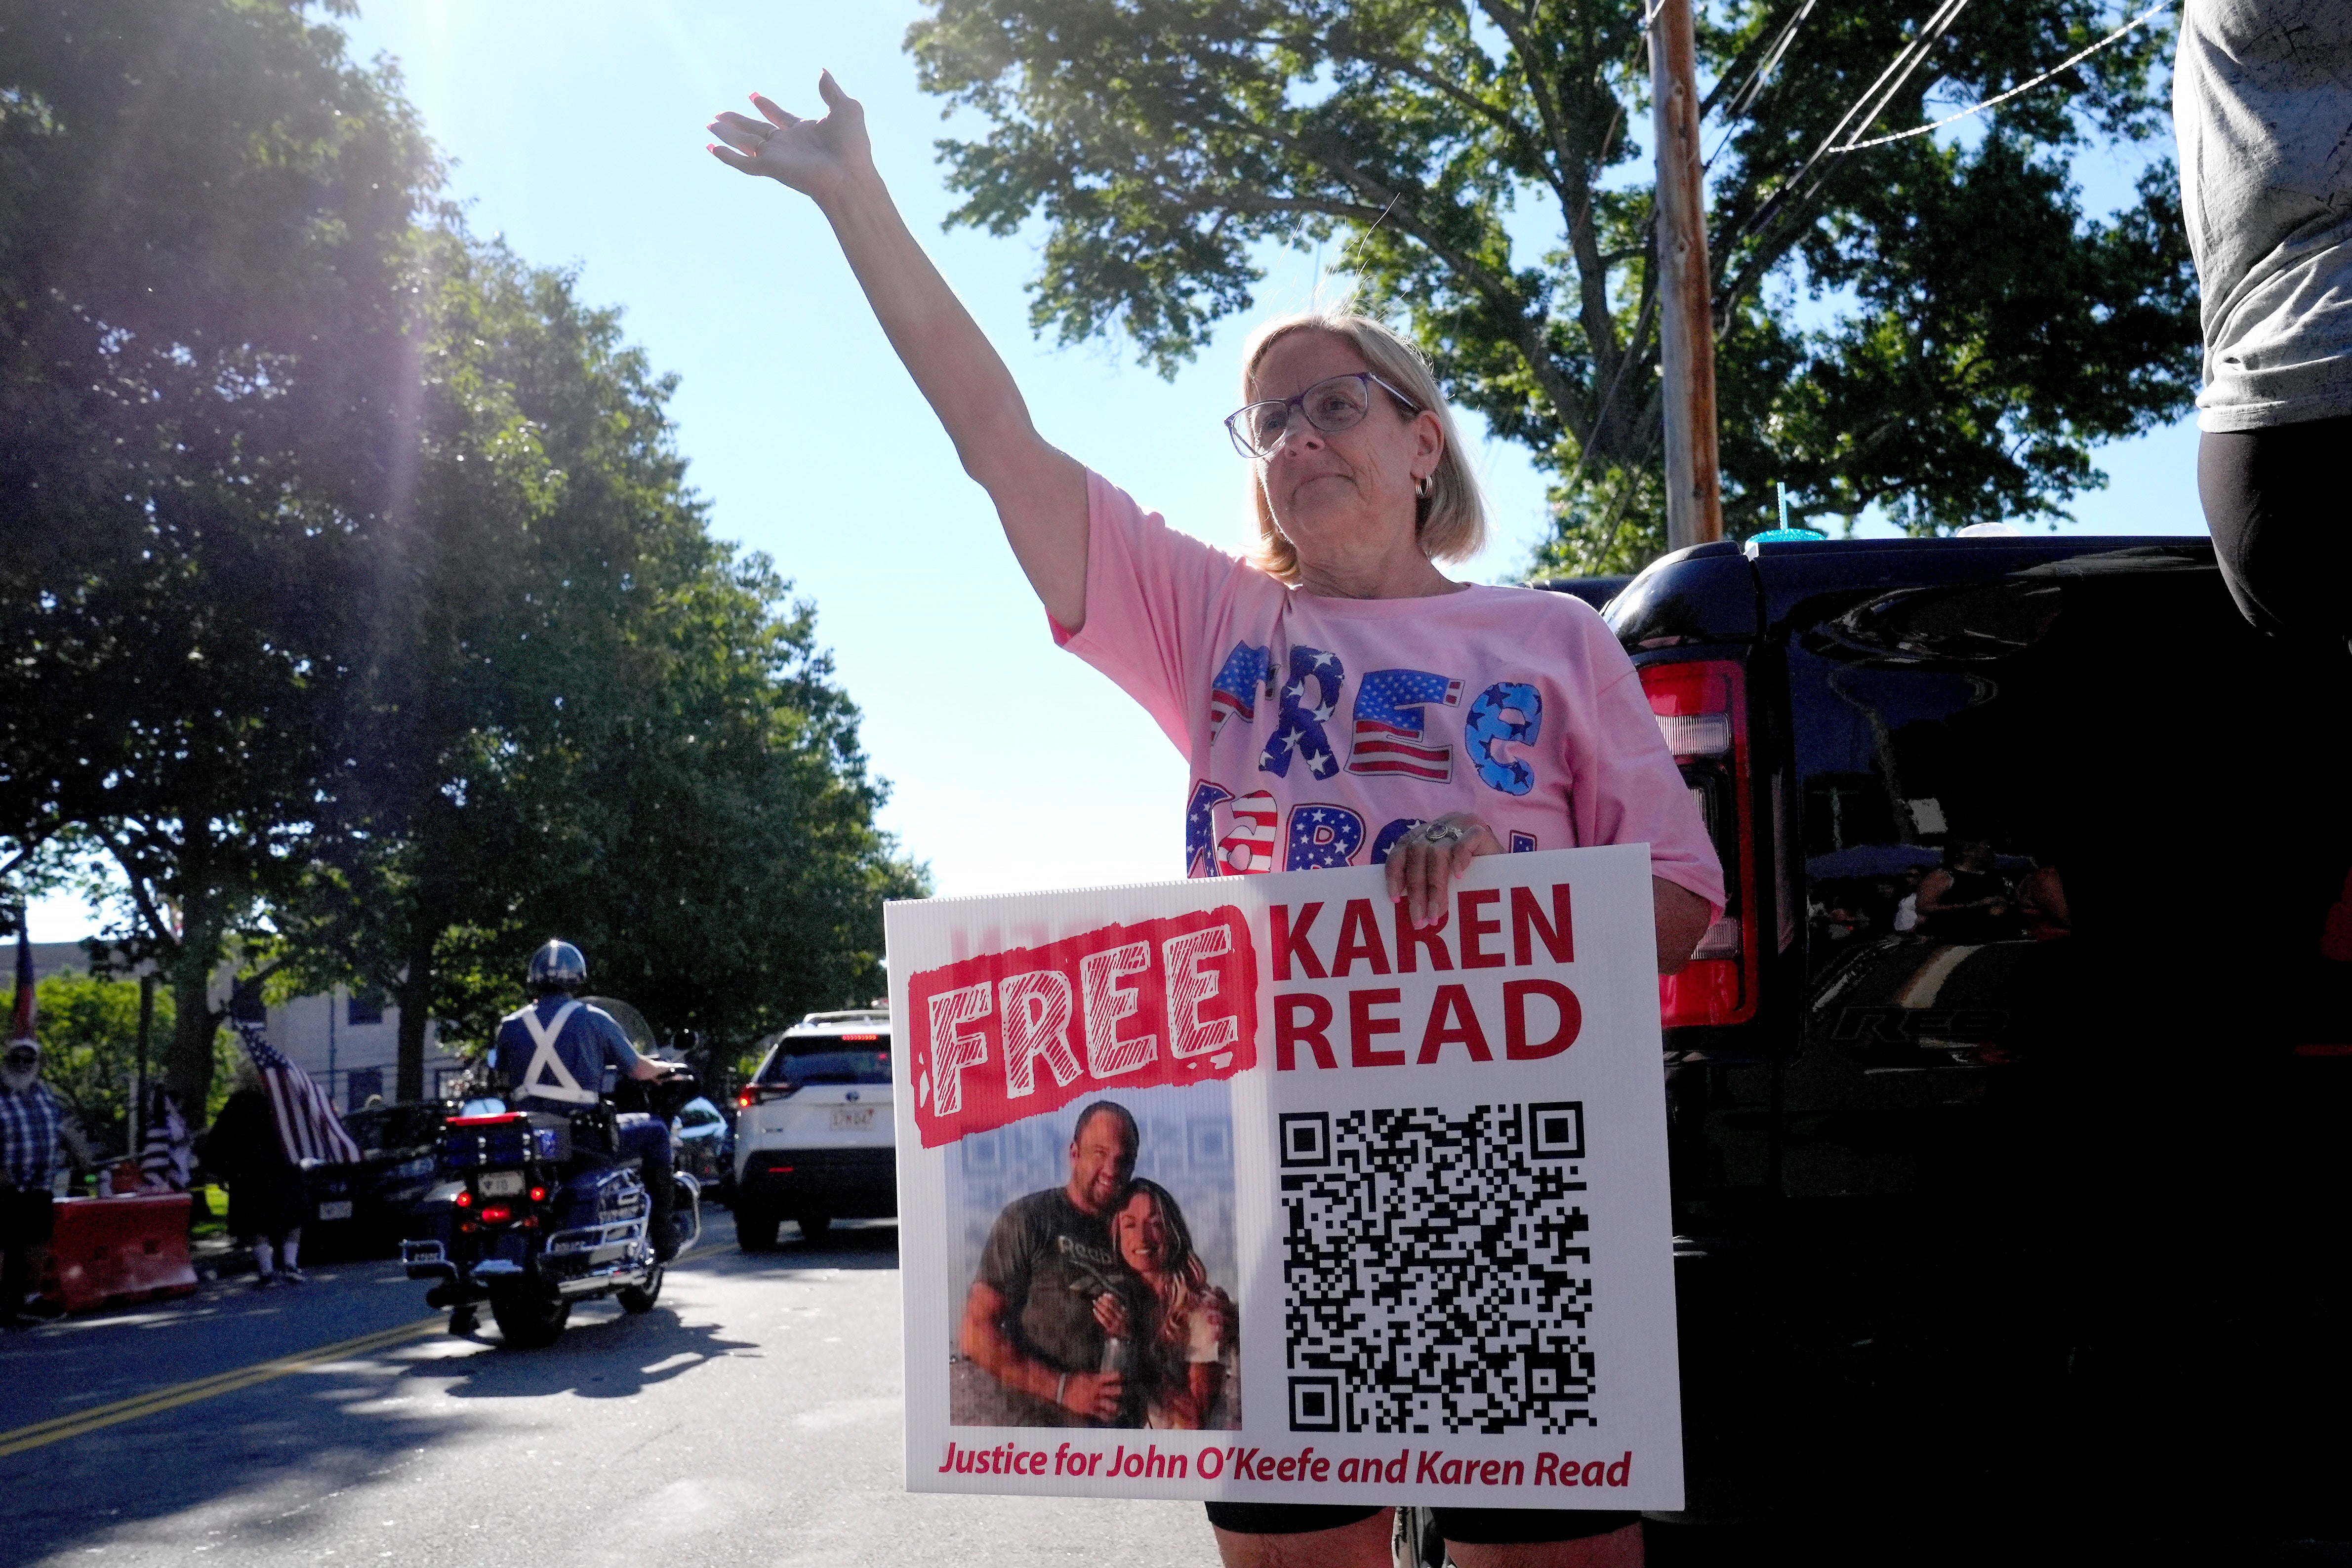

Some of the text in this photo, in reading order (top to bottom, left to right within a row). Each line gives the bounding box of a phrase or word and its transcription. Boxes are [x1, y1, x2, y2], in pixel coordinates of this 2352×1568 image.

[1269, 883, 1575, 981] KAREN
[928, 924, 1239, 1118] FREE
[1274, 979, 1582, 1071] READ
[939, 1442, 1631, 1487] Justice for John O’Keefe and Karen Read
